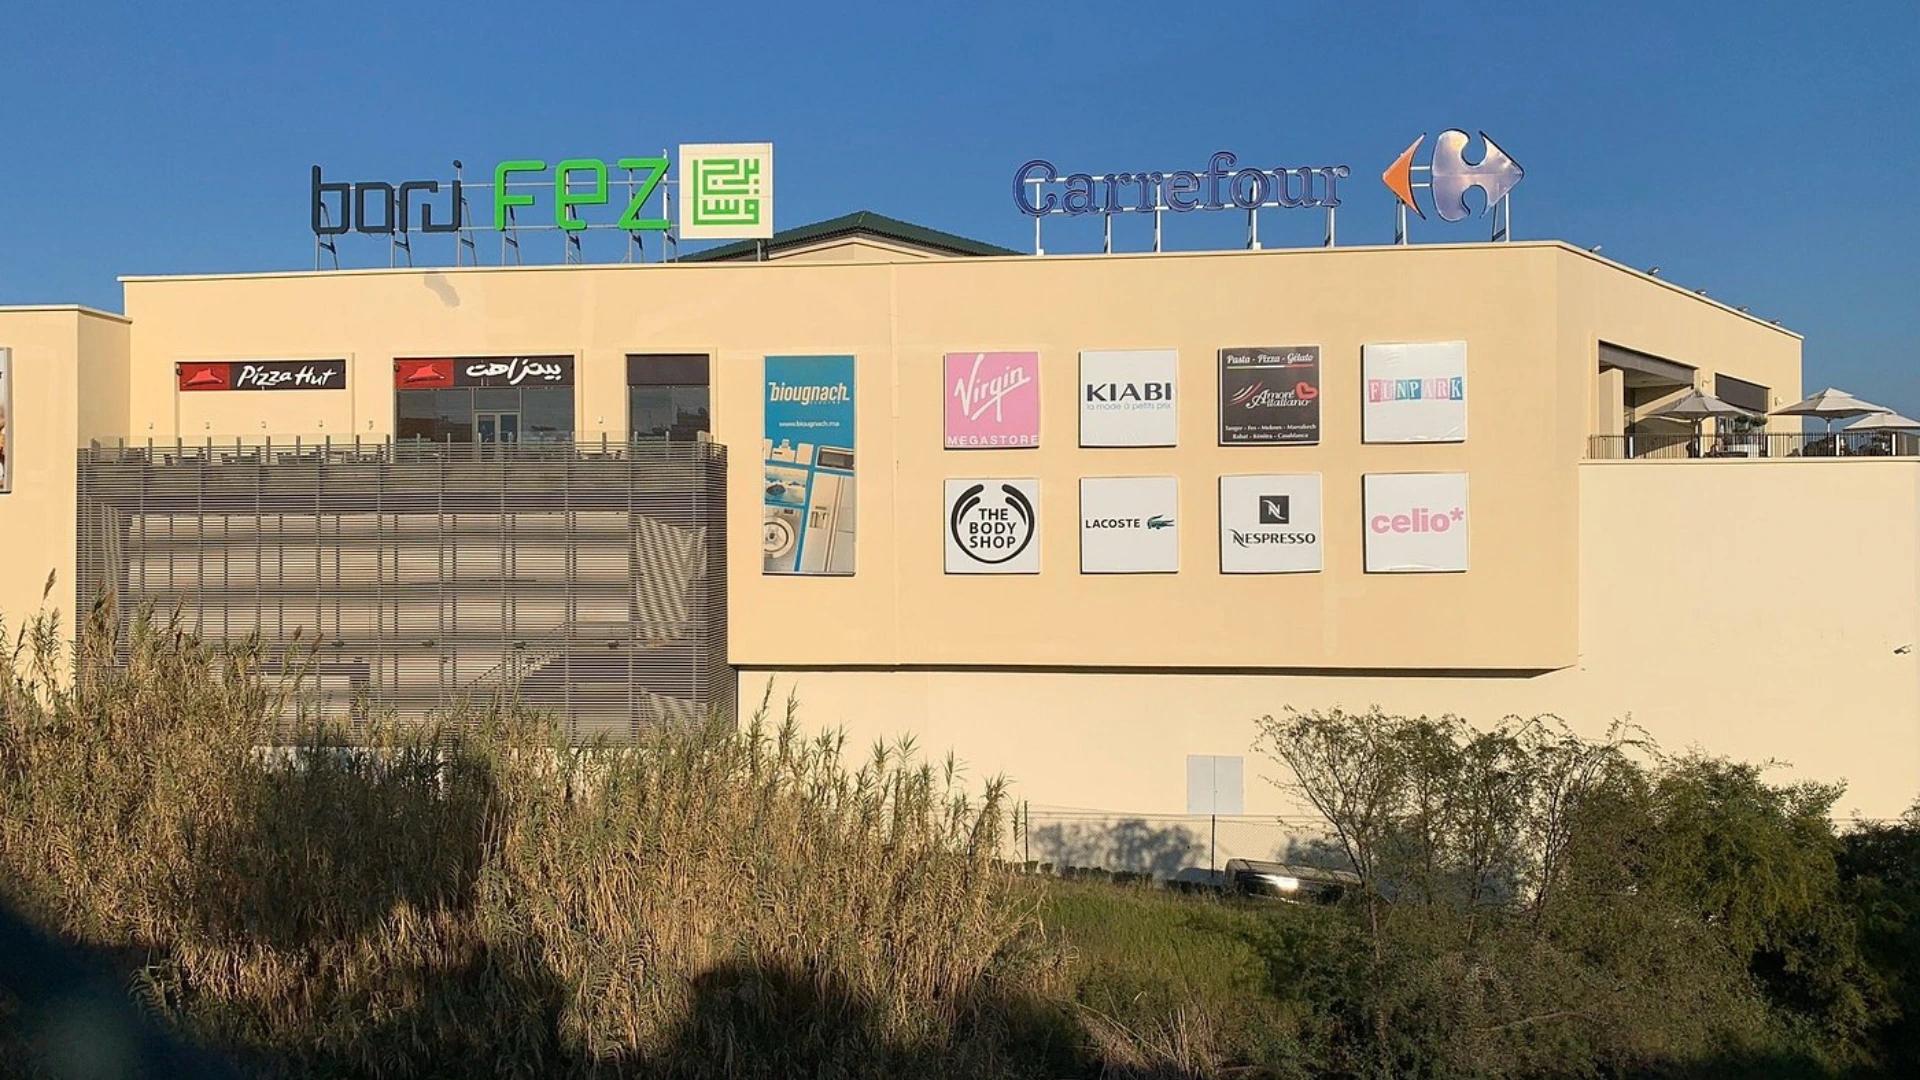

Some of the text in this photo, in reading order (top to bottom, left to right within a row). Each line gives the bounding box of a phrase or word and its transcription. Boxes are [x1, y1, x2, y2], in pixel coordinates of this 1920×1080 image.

[1012, 151, 1351, 217] Carrefour
[1226, 354, 1250, 364] Pasta
[1257, 354, 1280, 363] Pizza
[238, 364, 337, 388] Pizza Hut
[768, 381, 850, 406] biougnach
[954, 353, 1031, 423] Virgin
[1086, 382, 1172, 402] KIABI
[1368, 377, 1463, 403] FUNPARK
[1132, 401, 1155, 412] petits
[1156, 401, 1172, 412] prix
[947, 434, 1038, 446] MEGASTORE
[978, 508, 1009, 521] THE
[969, 521, 1017, 534] BODY
[1085, 518, 1141, 529] LACOSTE
[969, 535, 1017, 549] SHOP
[1229, 528, 1316, 548] NESPRESSO
